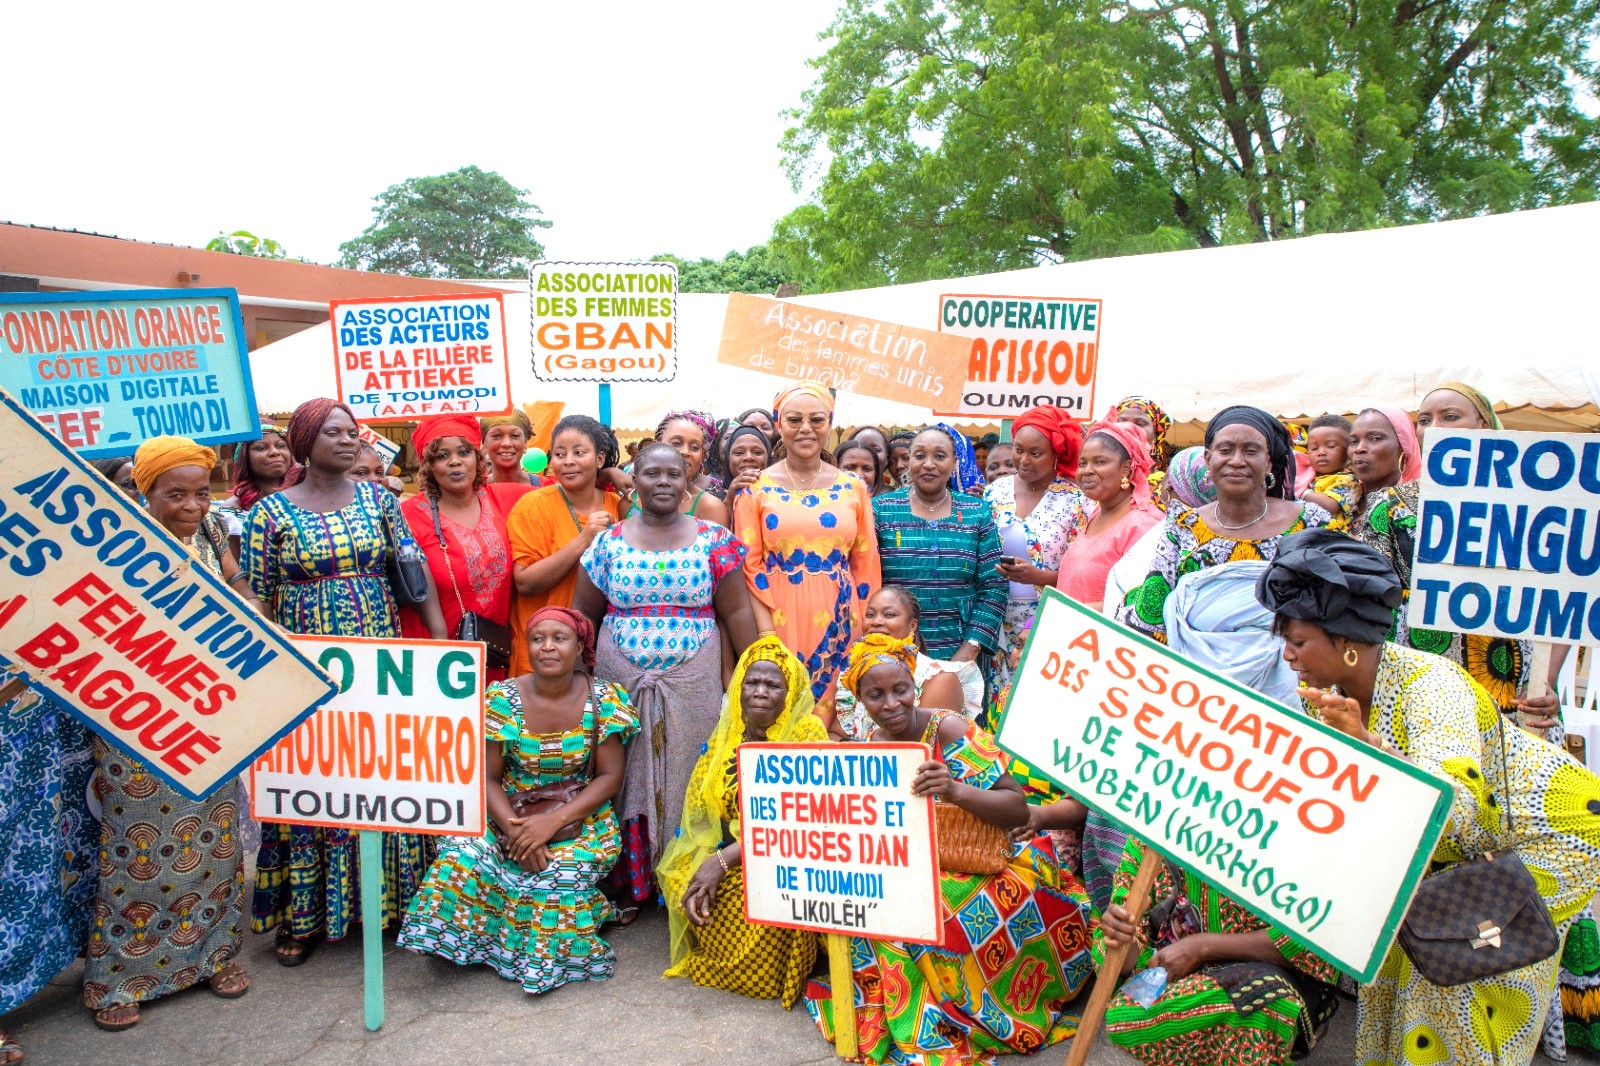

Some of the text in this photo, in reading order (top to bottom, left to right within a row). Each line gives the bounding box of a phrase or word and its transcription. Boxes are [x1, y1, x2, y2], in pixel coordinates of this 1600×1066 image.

[537, 273, 672, 293] ASSOCIATION
[343, 304, 490, 326] ASSOCIATION
[536, 297, 672, 317] DES FEMMES
[943, 300, 1097, 331] COOPERATIVE
[0, 304, 225, 353] ONDATION ORANGE
[341, 322, 489, 346] DES ACTEURS
[537, 322, 672, 350] GBAN
[765, 302, 927, 367] Association
[38, 350, 198, 380] CÔTE D'IVOIRE
[345, 343, 493, 370] DE LA FILIÈRE
[544, 354, 666, 373] (Gagou)
[750, 347, 776, 370] de
[778, 332, 944, 396] des femmes unis
[21, 375, 219, 409] MAISON DIGITALE
[349, 387, 496, 404] DE TOUMODI
[364, 367, 474, 391] ATTIEKE
[963, 392, 1083, 409] OUMODI
[13, 466, 278, 681] ASSOCIATION
[0, 499, 237, 715] ES FEMMES
[14, 622, 221, 776] BAGOUÉ
[1068, 629, 1379, 802] ASSOCIATION
[1040, 651, 1345, 834] DES SENOUFO
[755, 755, 898, 787] ASSOCIATION
[1082, 715, 1278, 850] DE TOUMODI
[267, 788, 464, 826] TOUMODI
[750, 792, 905, 827] DES FEMMES ET
[752, 827, 908, 867] EPOUSES DAN
[1053, 738, 1332, 932] WOBEN (KORHOGO)
[776, 865, 884, 899] DE TOUMODI
